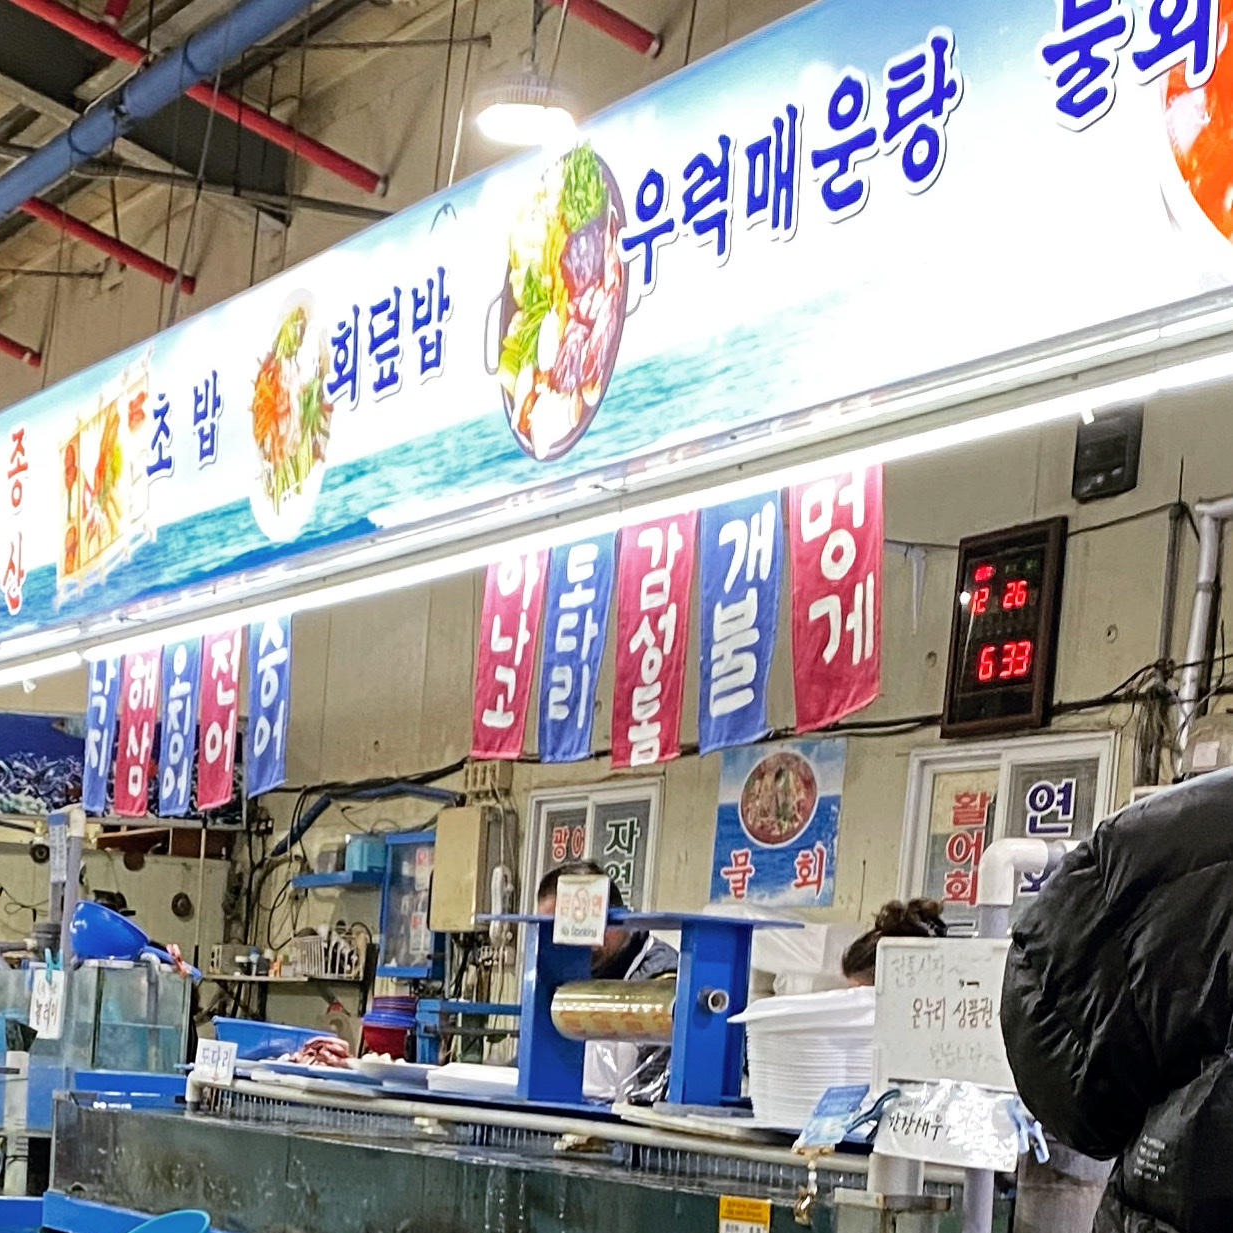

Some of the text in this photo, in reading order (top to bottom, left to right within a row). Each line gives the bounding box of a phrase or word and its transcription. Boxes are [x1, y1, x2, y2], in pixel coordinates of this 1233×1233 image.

[621, 35, 959, 285] 우럭매운탕
[326, 265, 451, 402] 회덮밥
[481, 552, 540, 729] 아나고
[547, 543, 599, 729] 도다리
[709, 501, 776, 718] 개불
[800, 470, 875, 666] 멍게
[1002, 580, 1028, 610] 26
[86, 660, 117, 778] 낙지
[204, 630, 243, 773] 전어
[628, 526, 683, 767] 감성돔
[126, 654, 158, 797] 해삼
[162, 643, 192, 807] 오징어
[942, 791, 992, 906] 활어회
[912, 996, 994, 1031] 온누리 상품권
